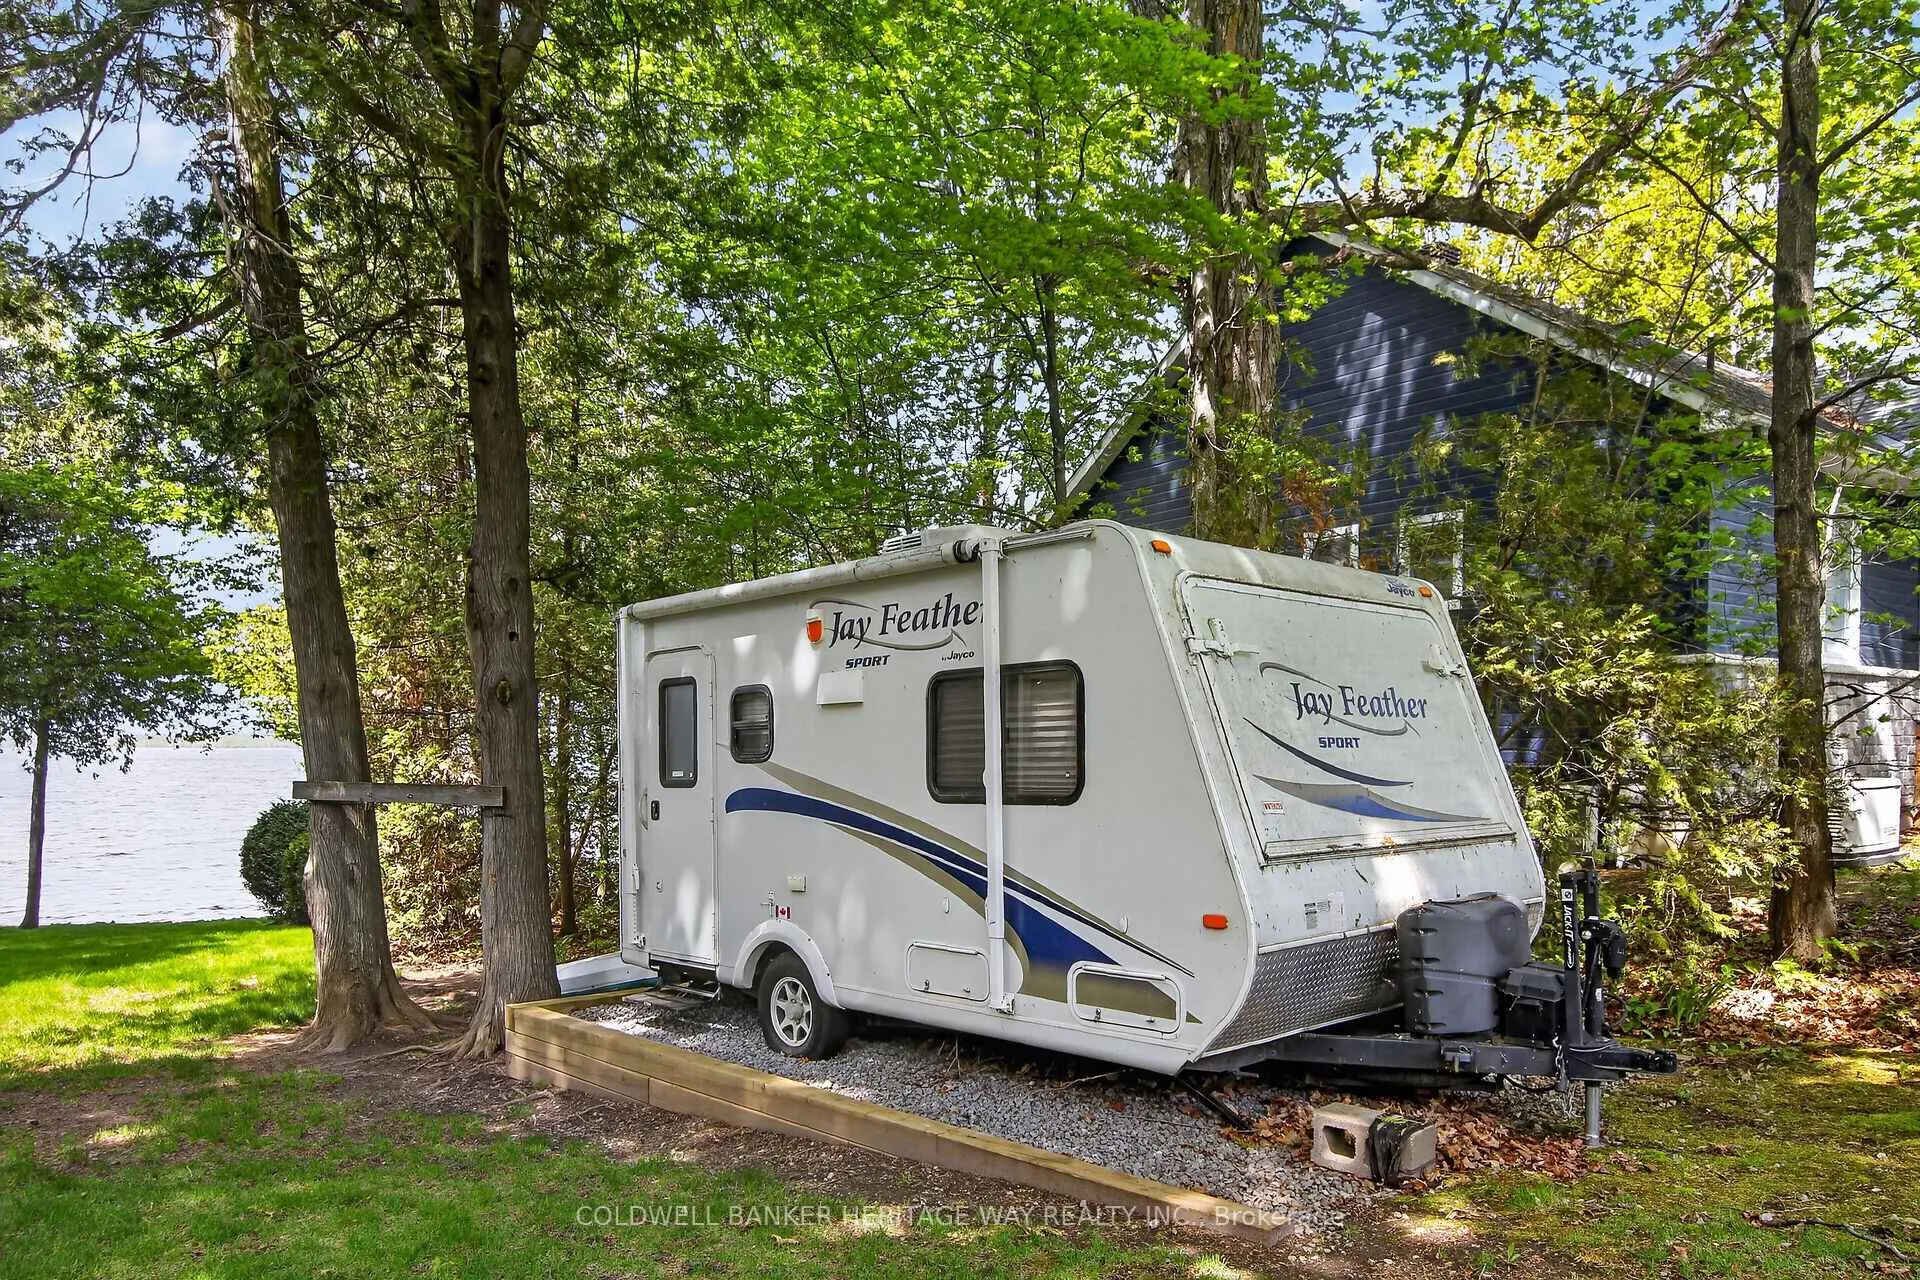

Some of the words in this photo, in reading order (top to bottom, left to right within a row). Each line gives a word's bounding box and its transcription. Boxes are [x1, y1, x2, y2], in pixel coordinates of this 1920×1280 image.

[1386, 583, 1415, 598] Jayco
[829, 611, 871, 649] Jay
[845, 654, 891, 669] SPORT
[947, 651, 975, 661] Jayco
[1290, 682, 1332, 725] Jay
[1338, 685, 1427, 719] Feather
[1318, 736, 1361, 749] SPORT
